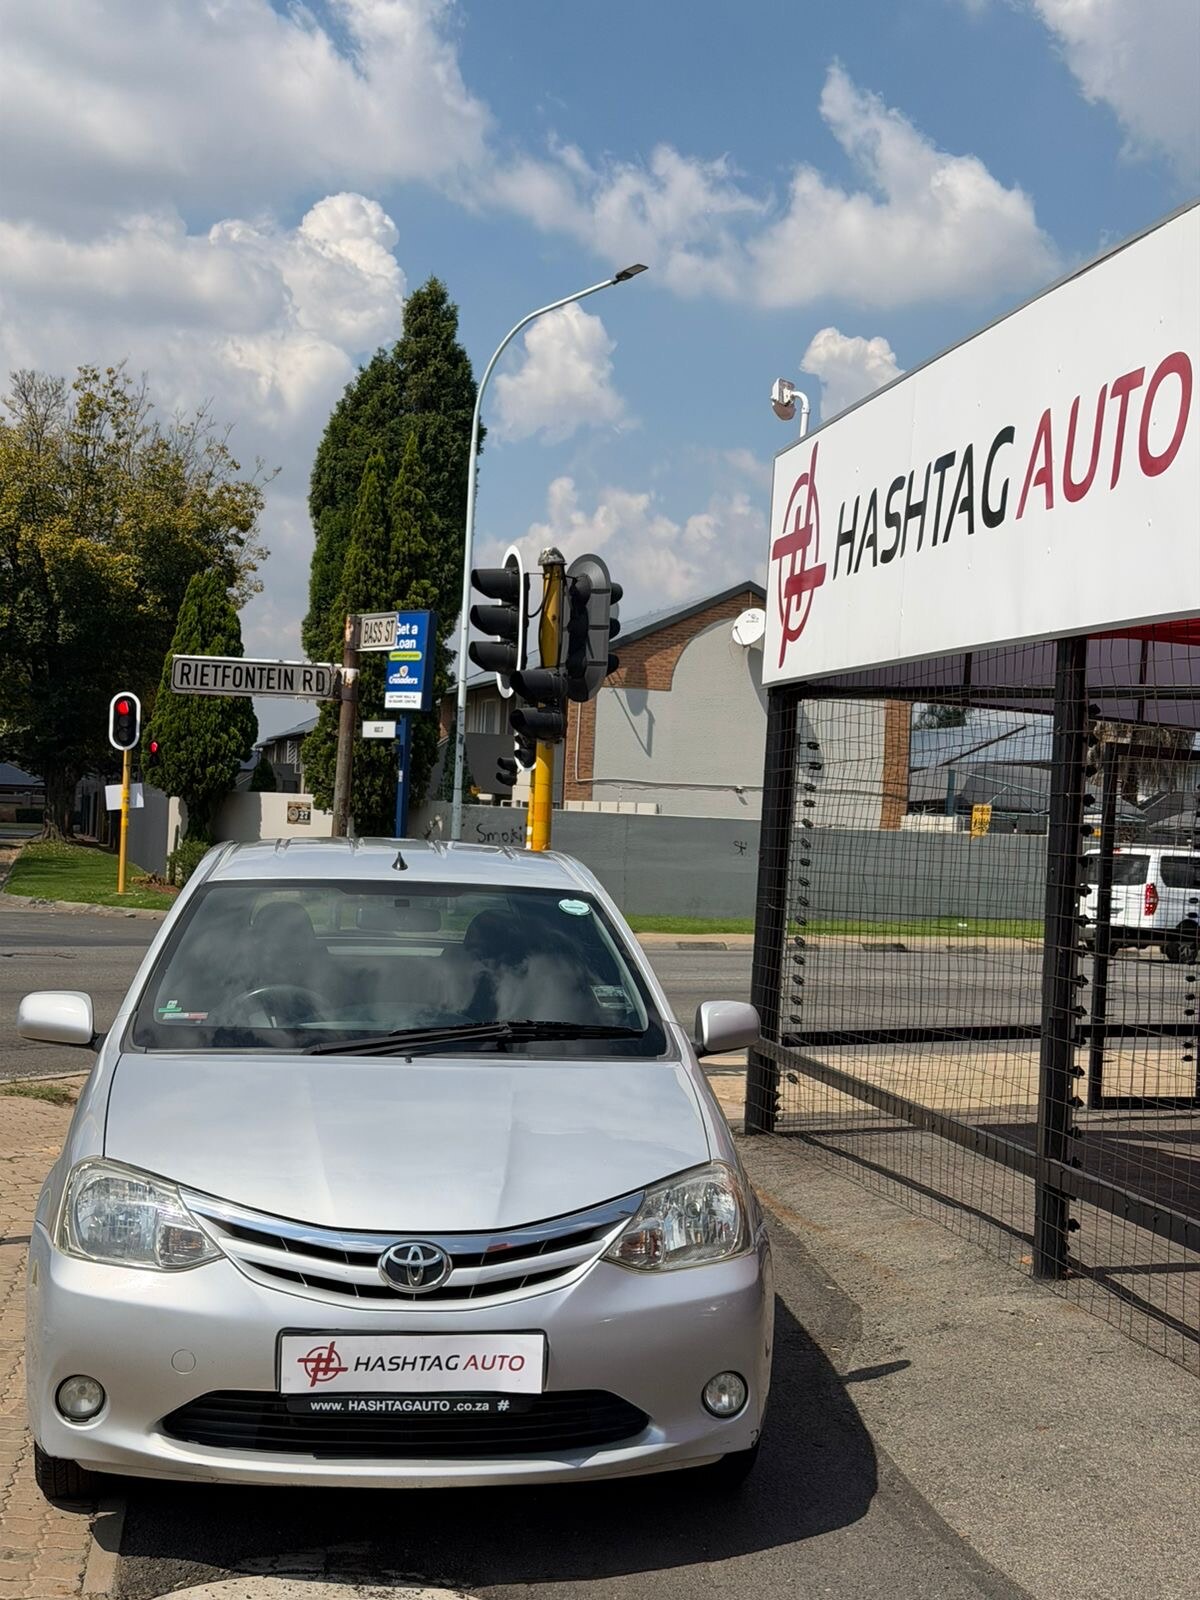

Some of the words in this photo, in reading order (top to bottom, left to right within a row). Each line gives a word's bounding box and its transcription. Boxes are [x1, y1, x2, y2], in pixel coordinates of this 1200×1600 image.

[832, 425, 1016, 580] HASHTAG
[1015, 351, 1193, 520] AUTO
[363, 621, 382, 643] BASS
[384, 620, 395, 642] ST
[411, 624, 418, 635] a
[180, 662, 294, 691] RIETFONTEIN
[302, 669, 325, 693] RD
[354, 1355, 460, 1371] HASHTAG
[462, 1355, 525, 1371] AUTO
[310, 1402, 344, 1411] www.
[349, 1400, 450, 1412] HASHTAGAUTO
[453, 1401, 489, 1411] .co.za
